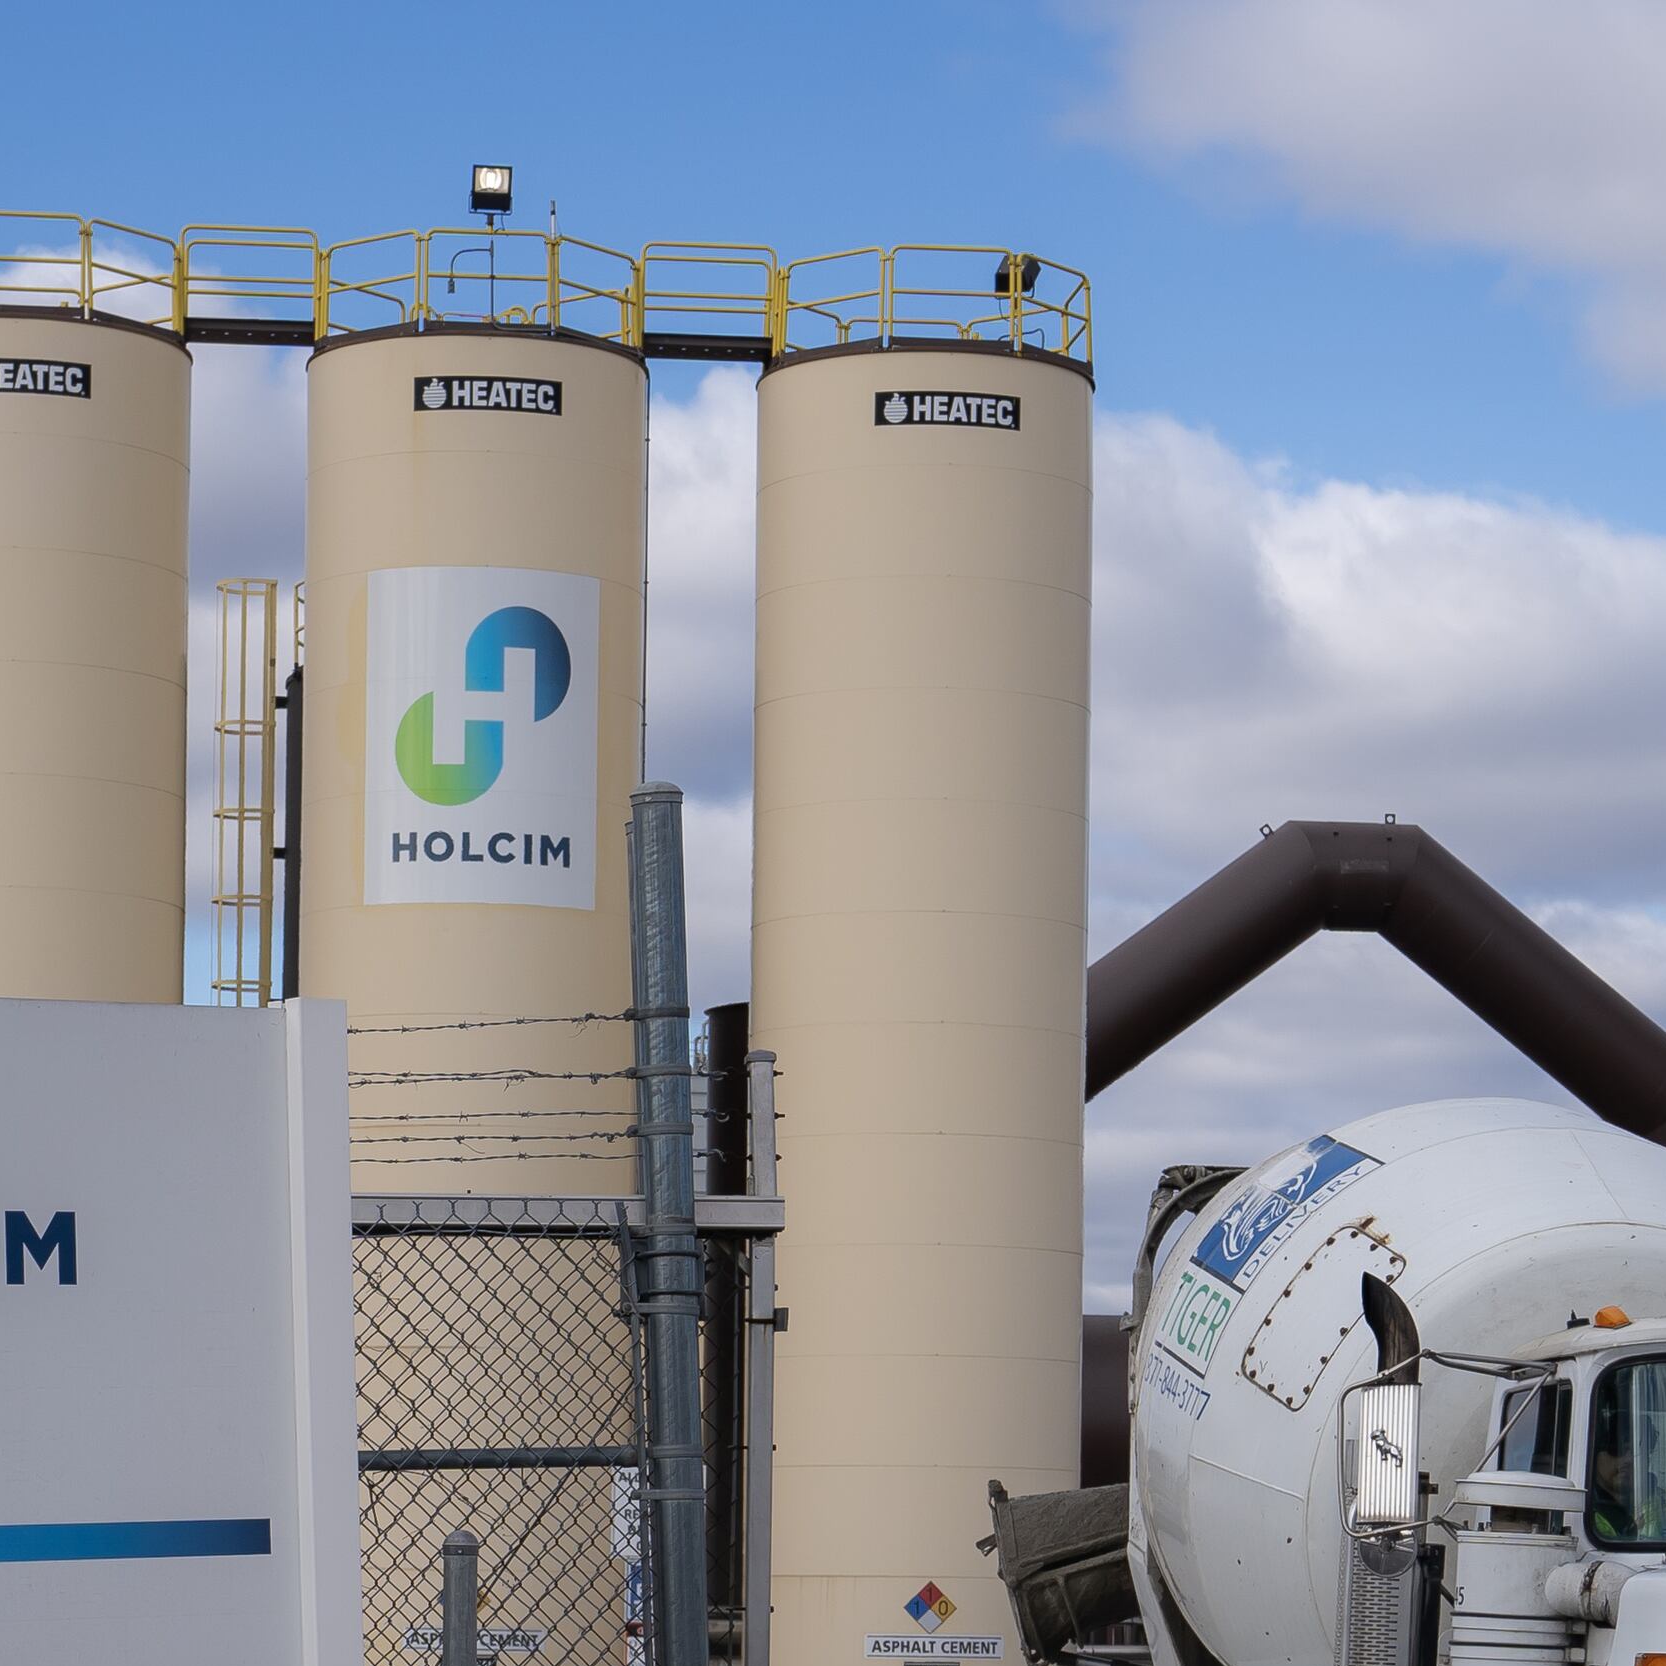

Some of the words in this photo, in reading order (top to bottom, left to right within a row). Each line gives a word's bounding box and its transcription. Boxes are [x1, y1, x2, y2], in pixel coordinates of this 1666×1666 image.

[451, 380, 555, 411] HEATEC
[912, 395, 1014, 426] HEATEC
[392, 830, 571, 868] HOLCIM
[1244, 1165, 1362, 1279] DELIVERY
[1161, 1271, 1230, 1362] TIGER
[938, 1601, 949, 1616] 0
[871, 1640, 936, 1653] ASPHALT
[941, 1641, 998, 1655] CEMENT
